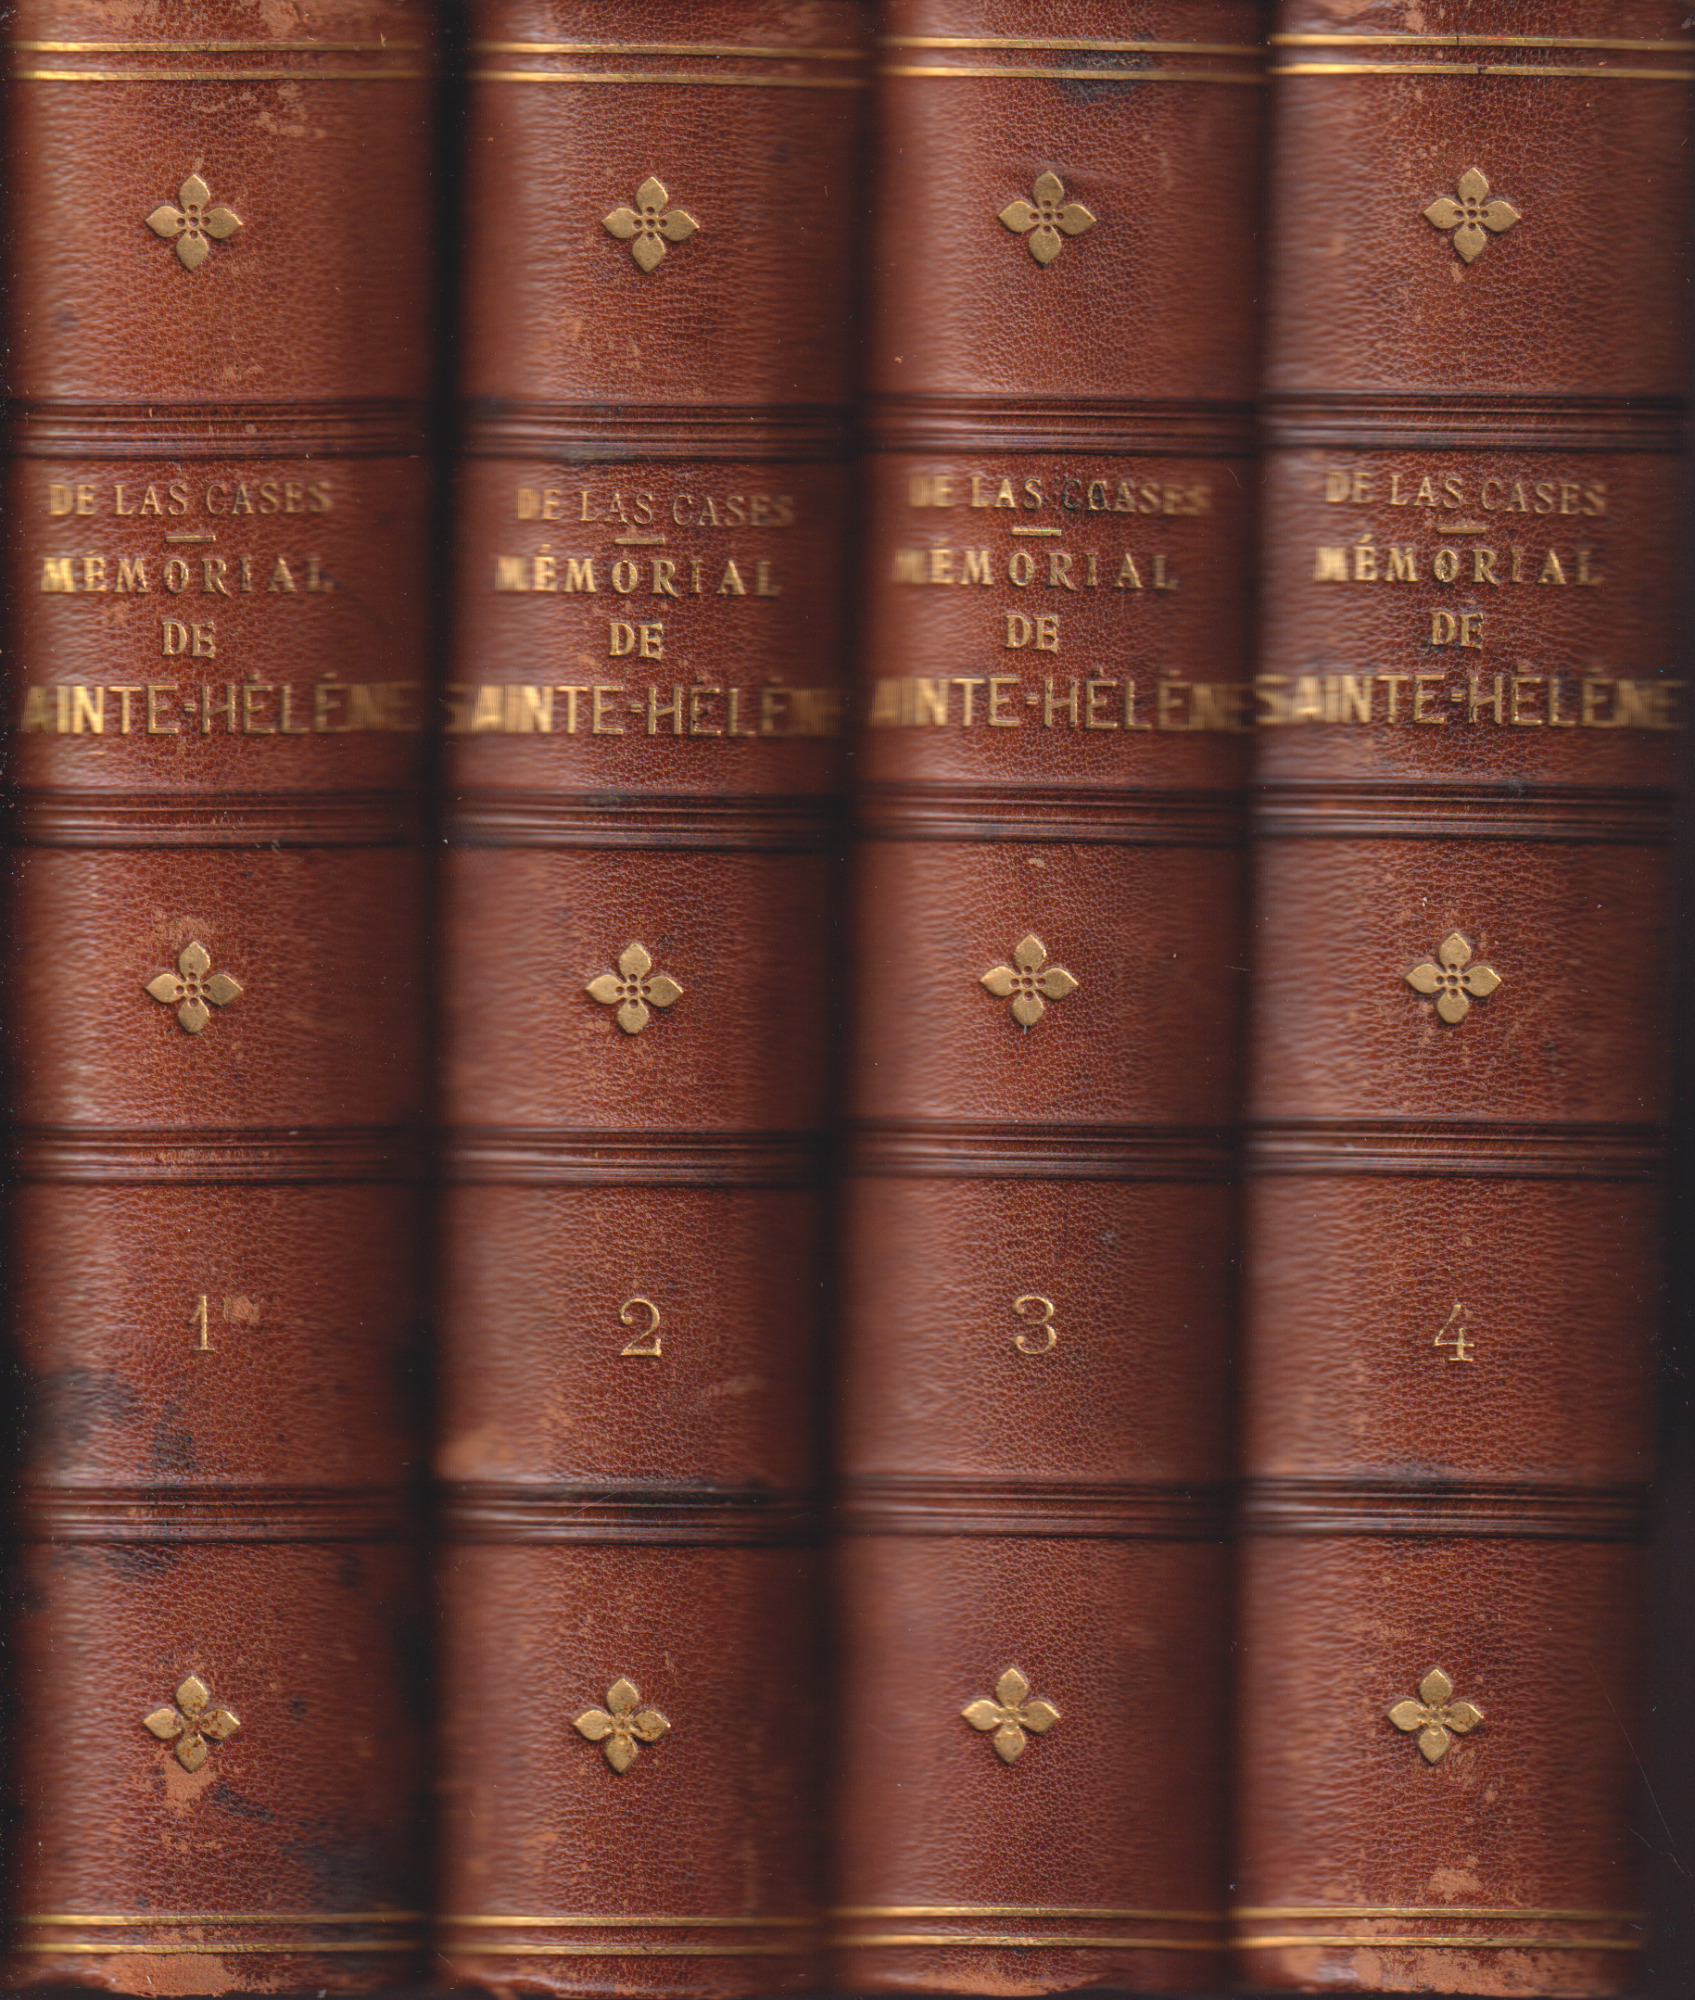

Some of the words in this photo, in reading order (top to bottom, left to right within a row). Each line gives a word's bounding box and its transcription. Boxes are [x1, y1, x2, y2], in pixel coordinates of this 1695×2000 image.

[49, 483, 99, 516] DE
[113, 483, 188, 516] LAS
[205, 481, 334, 515] CASES
[517, 487, 562, 521] DE
[579, 490, 653, 525] LAS
[672, 495, 796, 528] CASES
[969, 476, 1043, 511] LAS
[1325, 471, 1372, 503] DE
[1390, 474, 1464, 509] LAS
[1481, 480, 1606, 516] CASES
[40, 549, 335, 597] MÉMORIAL
[494, 543, 783, 598] MÉMORIAL
[893, 537, 1179, 591] MÉMORIAL
[1312, 533, 1601, 586] MÉMORIAL
[161, 621, 216, 659] DE
[608, 621, 664, 661] DE
[1005, 613, 1059, 654] DE
[1430, 611, 1484, 650] DE
[188, 1295, 215, 1353] 1
[619, 1297, 662, 1357] 2
[1011, 1294, 1058, 1355] 3
[1433, 1303, 1474, 1363] 4
